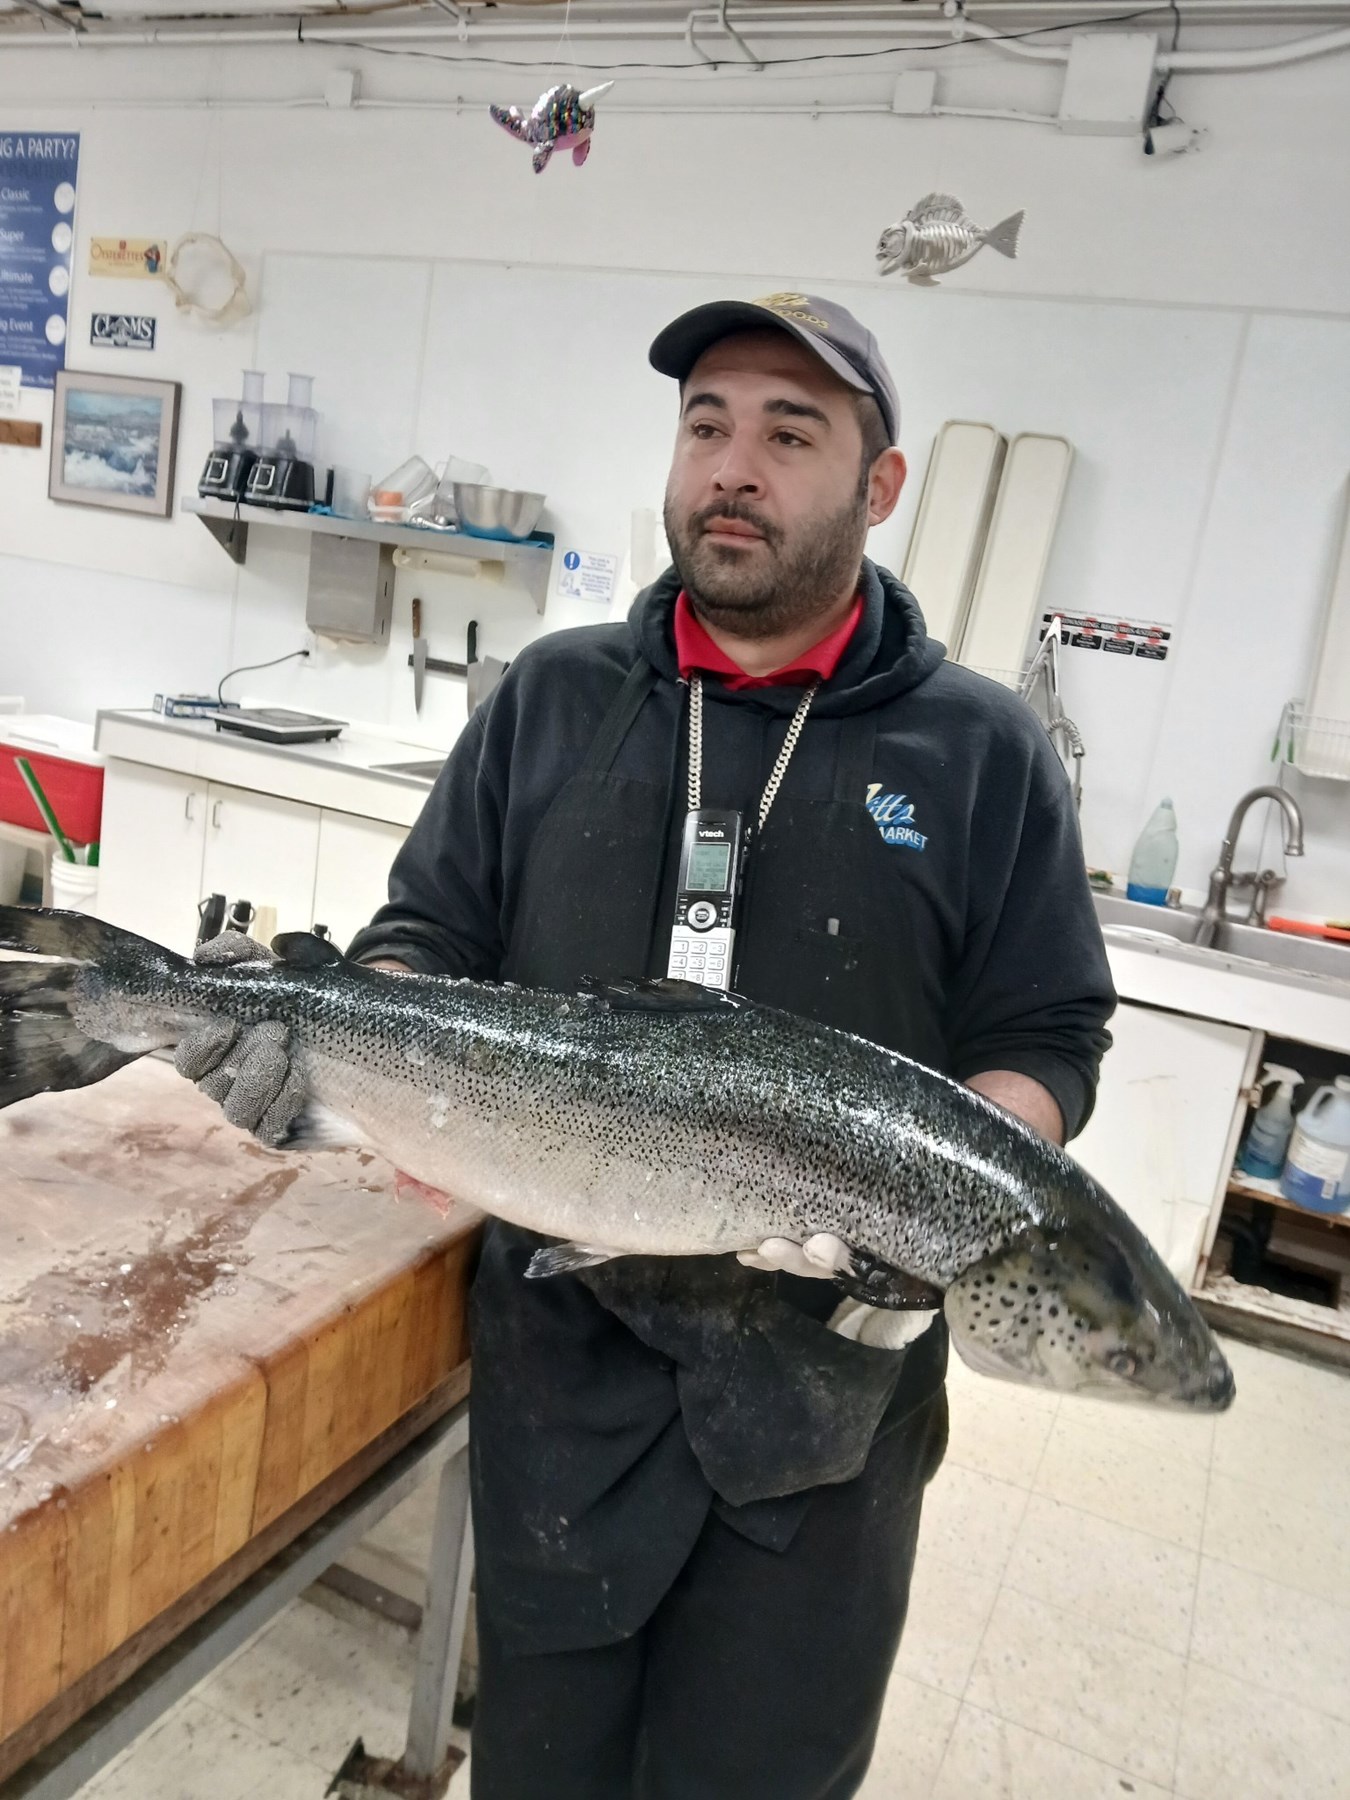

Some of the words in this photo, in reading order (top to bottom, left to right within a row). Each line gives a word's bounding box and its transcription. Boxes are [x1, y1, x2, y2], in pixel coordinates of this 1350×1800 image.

[15, 138, 25, 158] A
[28, 137, 76, 160] PARTY?
[1, 187, 30, 201] Classic
[9, 318, 33, 333] Event
[698, 830, 724, 838] vtech
